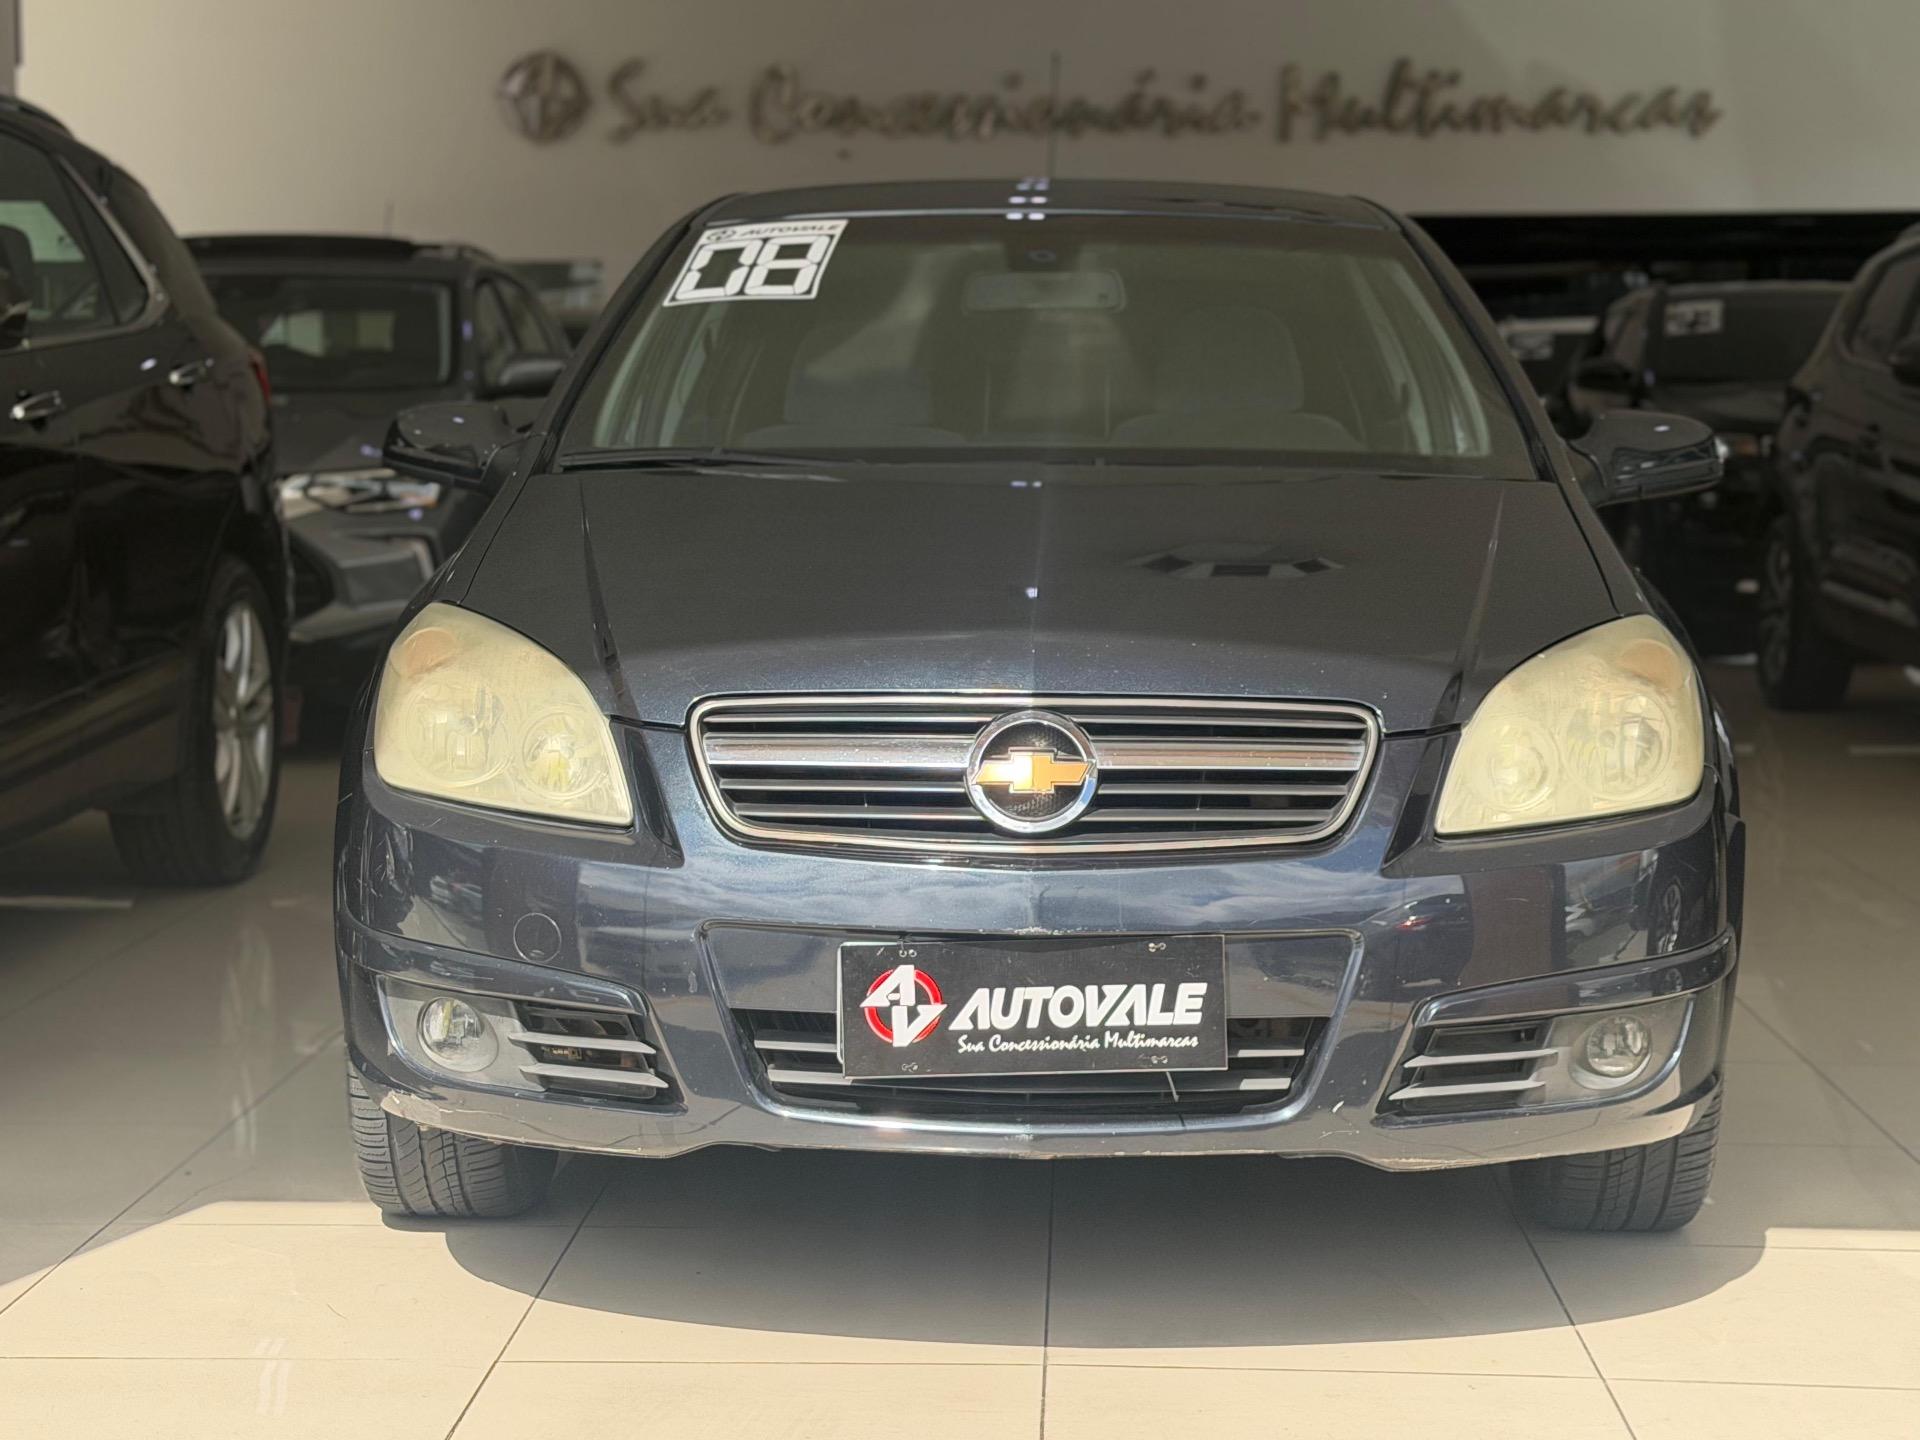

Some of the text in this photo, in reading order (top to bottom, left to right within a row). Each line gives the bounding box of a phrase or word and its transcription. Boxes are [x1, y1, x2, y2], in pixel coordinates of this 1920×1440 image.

[674, 234, 831, 300] 08
[948, 982, 1208, 1031] AUTOVALE
[957, 1030, 1199, 1054] Sua Concessionária Multimarcas
